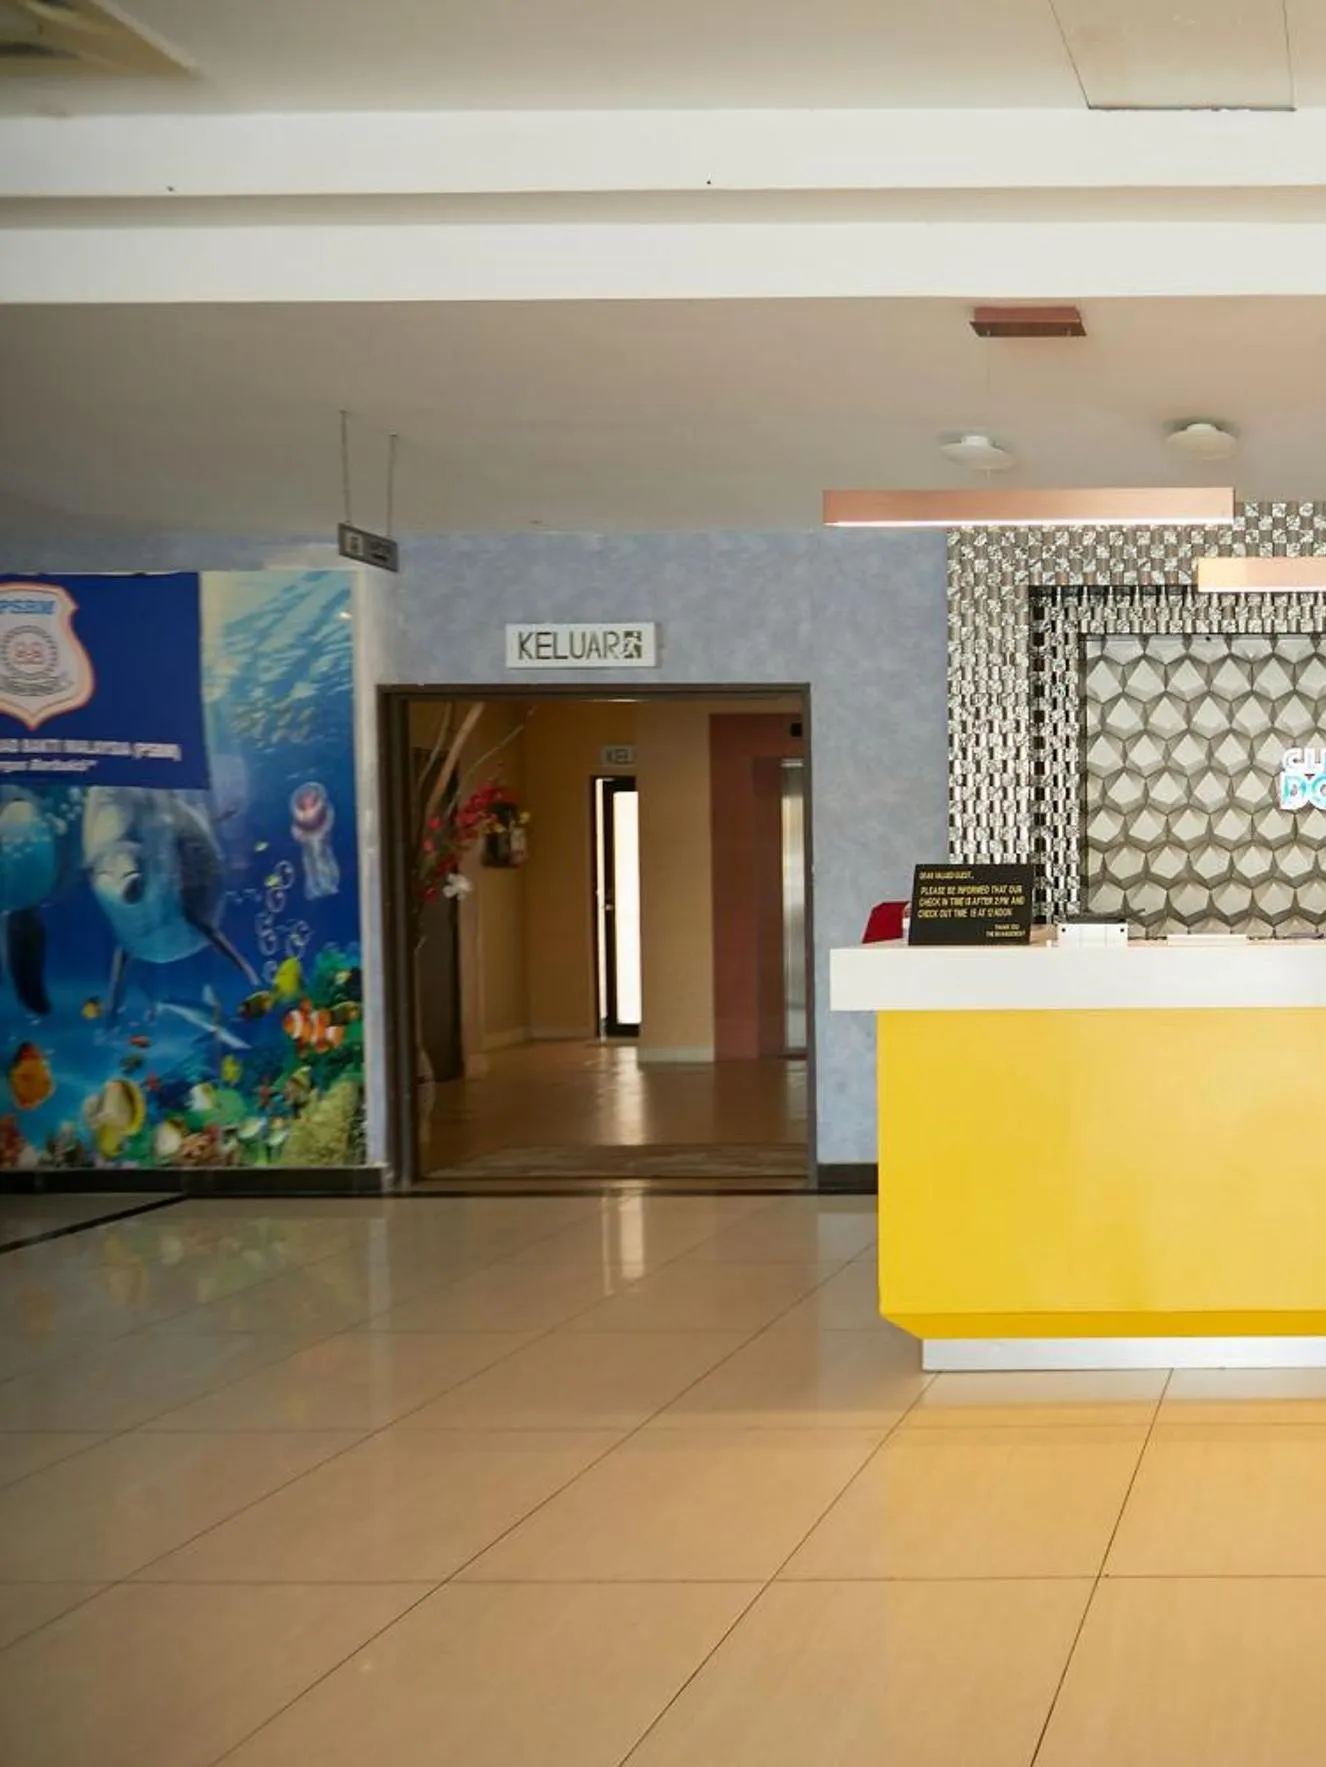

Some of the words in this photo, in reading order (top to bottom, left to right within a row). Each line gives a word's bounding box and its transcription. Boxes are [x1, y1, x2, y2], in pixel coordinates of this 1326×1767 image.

[517, 631, 620, 660] KELUAR
[920, 885, 945, 895] PLEASE
[957, 885, 990, 894] INFORMED
[991, 884, 1007, 894] THAT
[1009, 884, 1022, 894] OUR
[919, 897, 941, 906] CHECK
[972, 896, 993, 905] AFTER
[917, 909, 939, 918] CHECK
